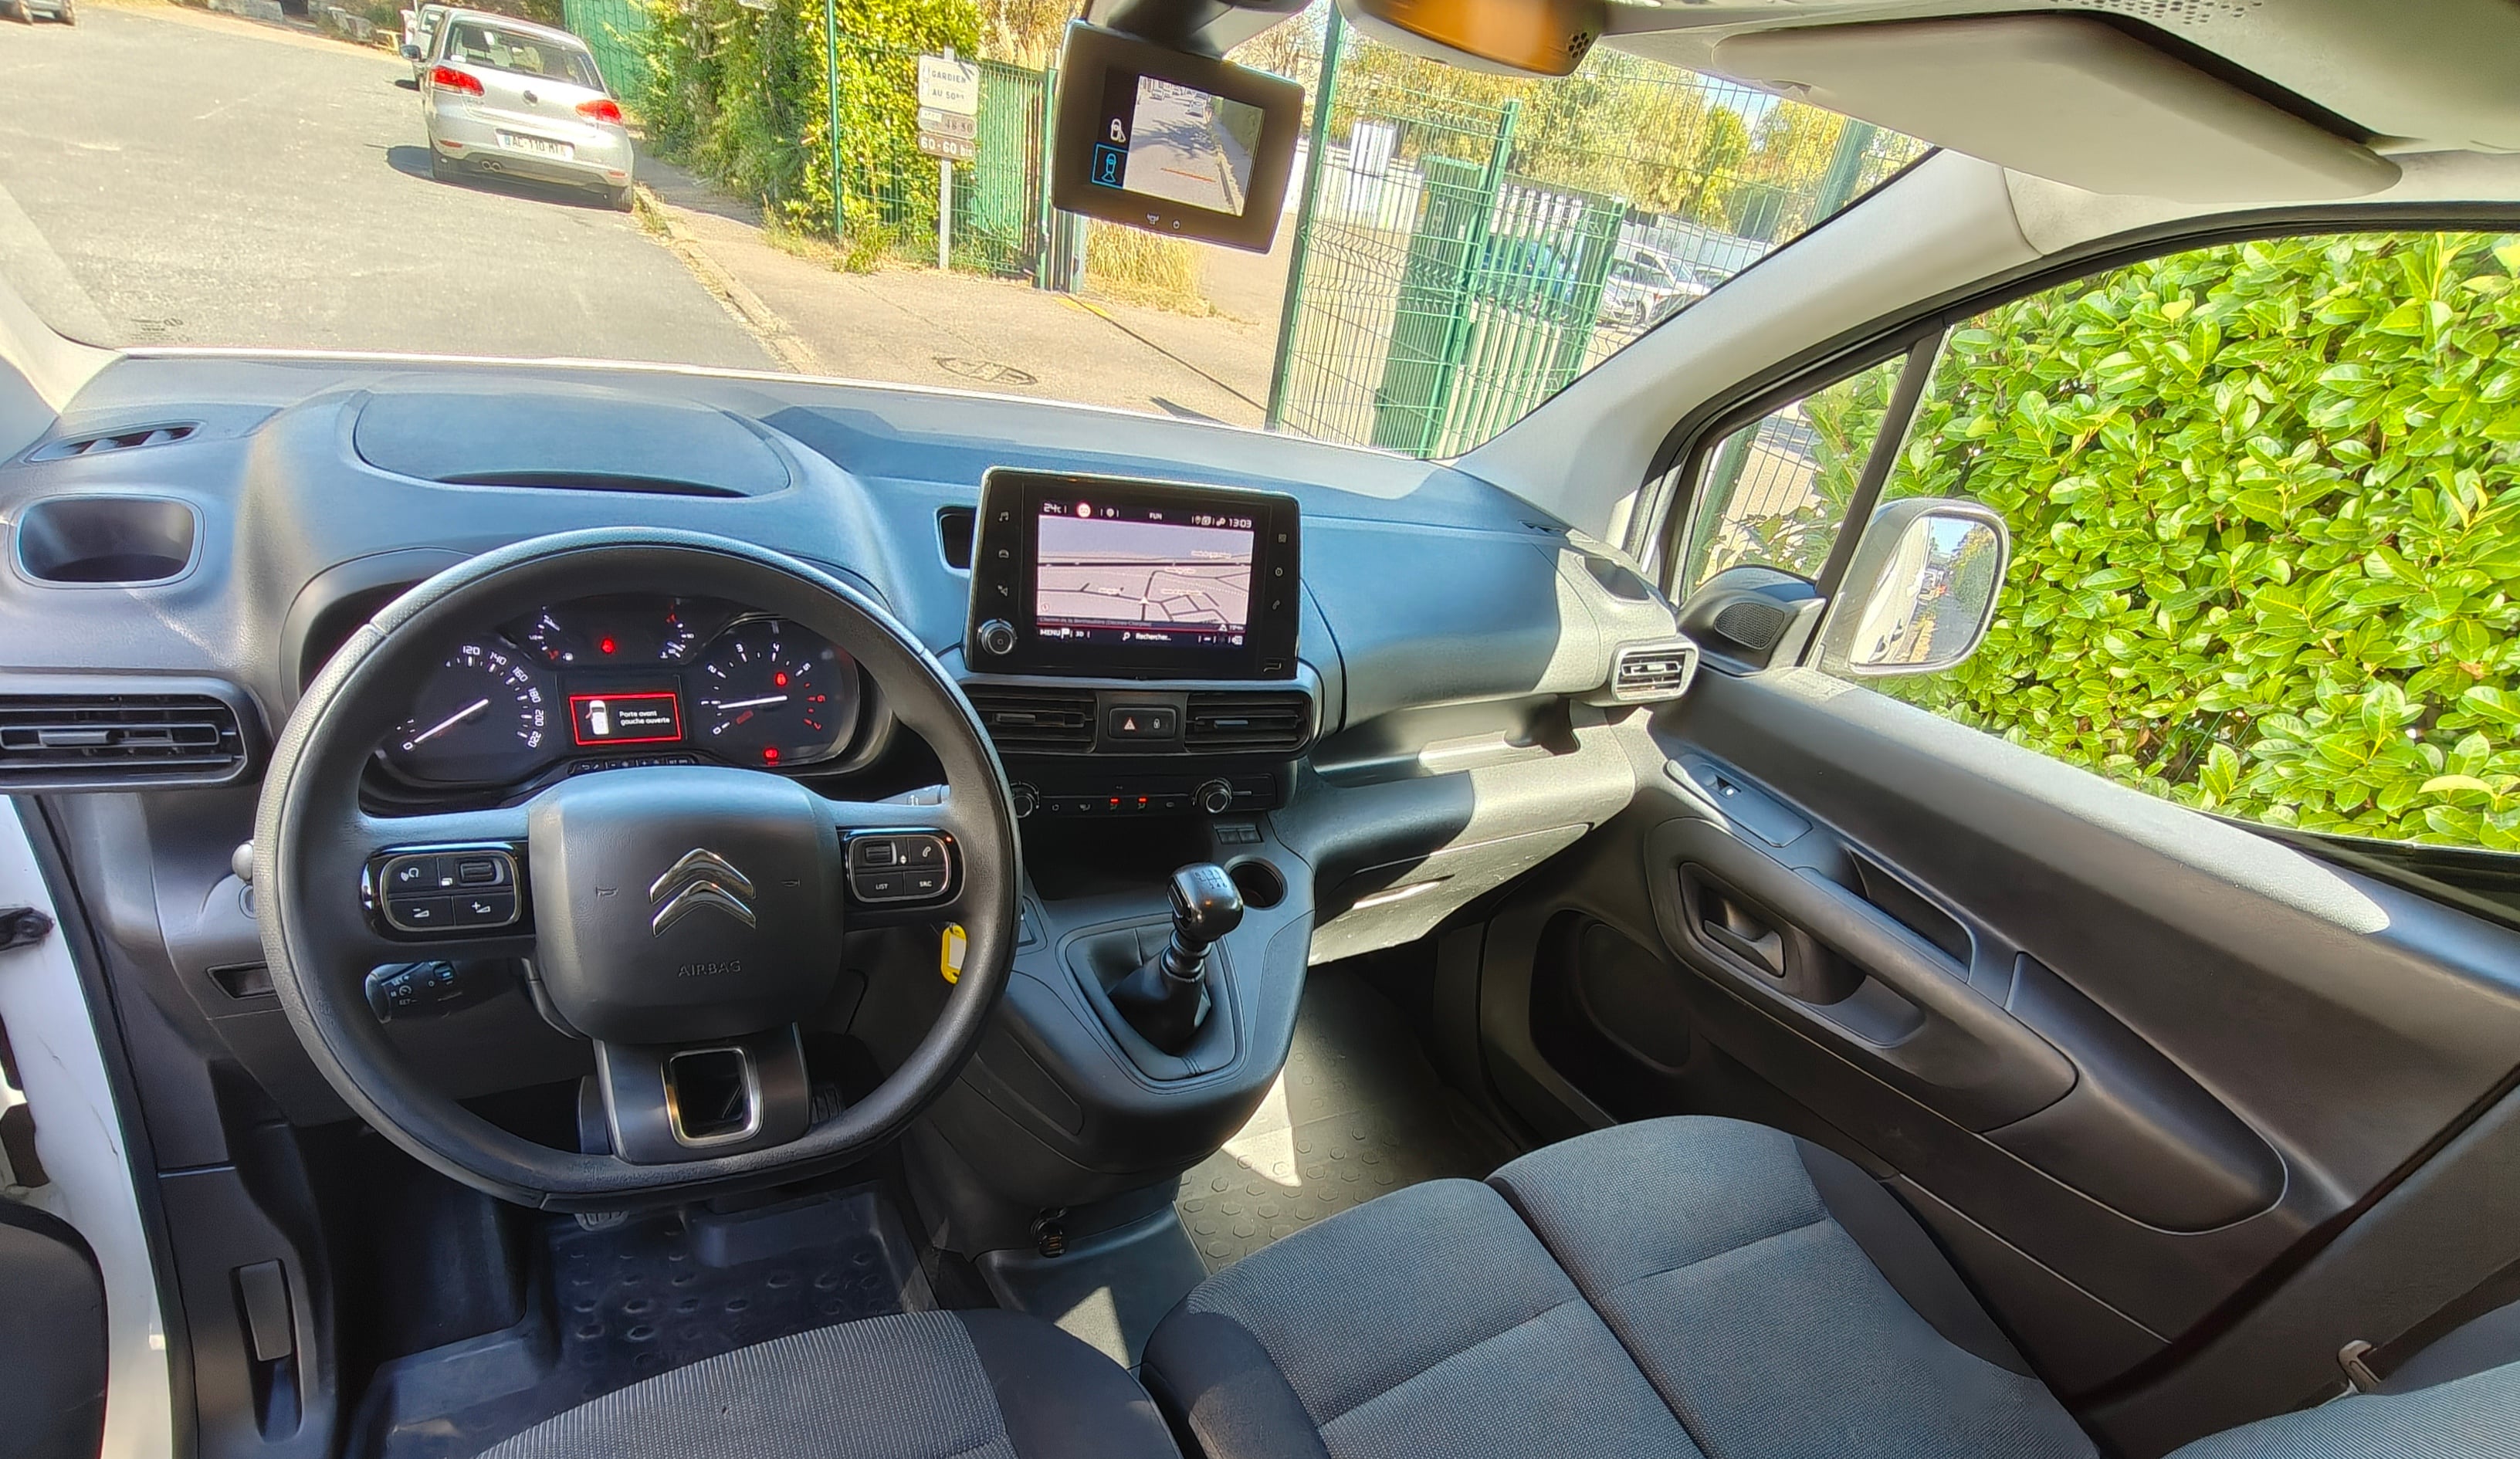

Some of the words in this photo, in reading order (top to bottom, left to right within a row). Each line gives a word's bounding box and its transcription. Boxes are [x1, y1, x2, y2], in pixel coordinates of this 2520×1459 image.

[931, 70, 967, 83] GARDIEN
[932, 88, 943, 97] AU
[462, 645, 480, 655] 120
[736, 644, 743, 652] 3
[773, 643, 780, 652] 4
[489, 652, 507, 665] 140
[707, 665, 716, 673] 2
[802, 662, 811, 672] 5
[511, 666, 528, 682] 160
[527, 687, 541, 703] 180
[534, 709, 544, 726] 200
[620, 718, 645, 726] gauche
[527, 730, 542, 748] 220
[402, 742, 414, 750] 0
[678, 960, 741, 978] AIRBAG
